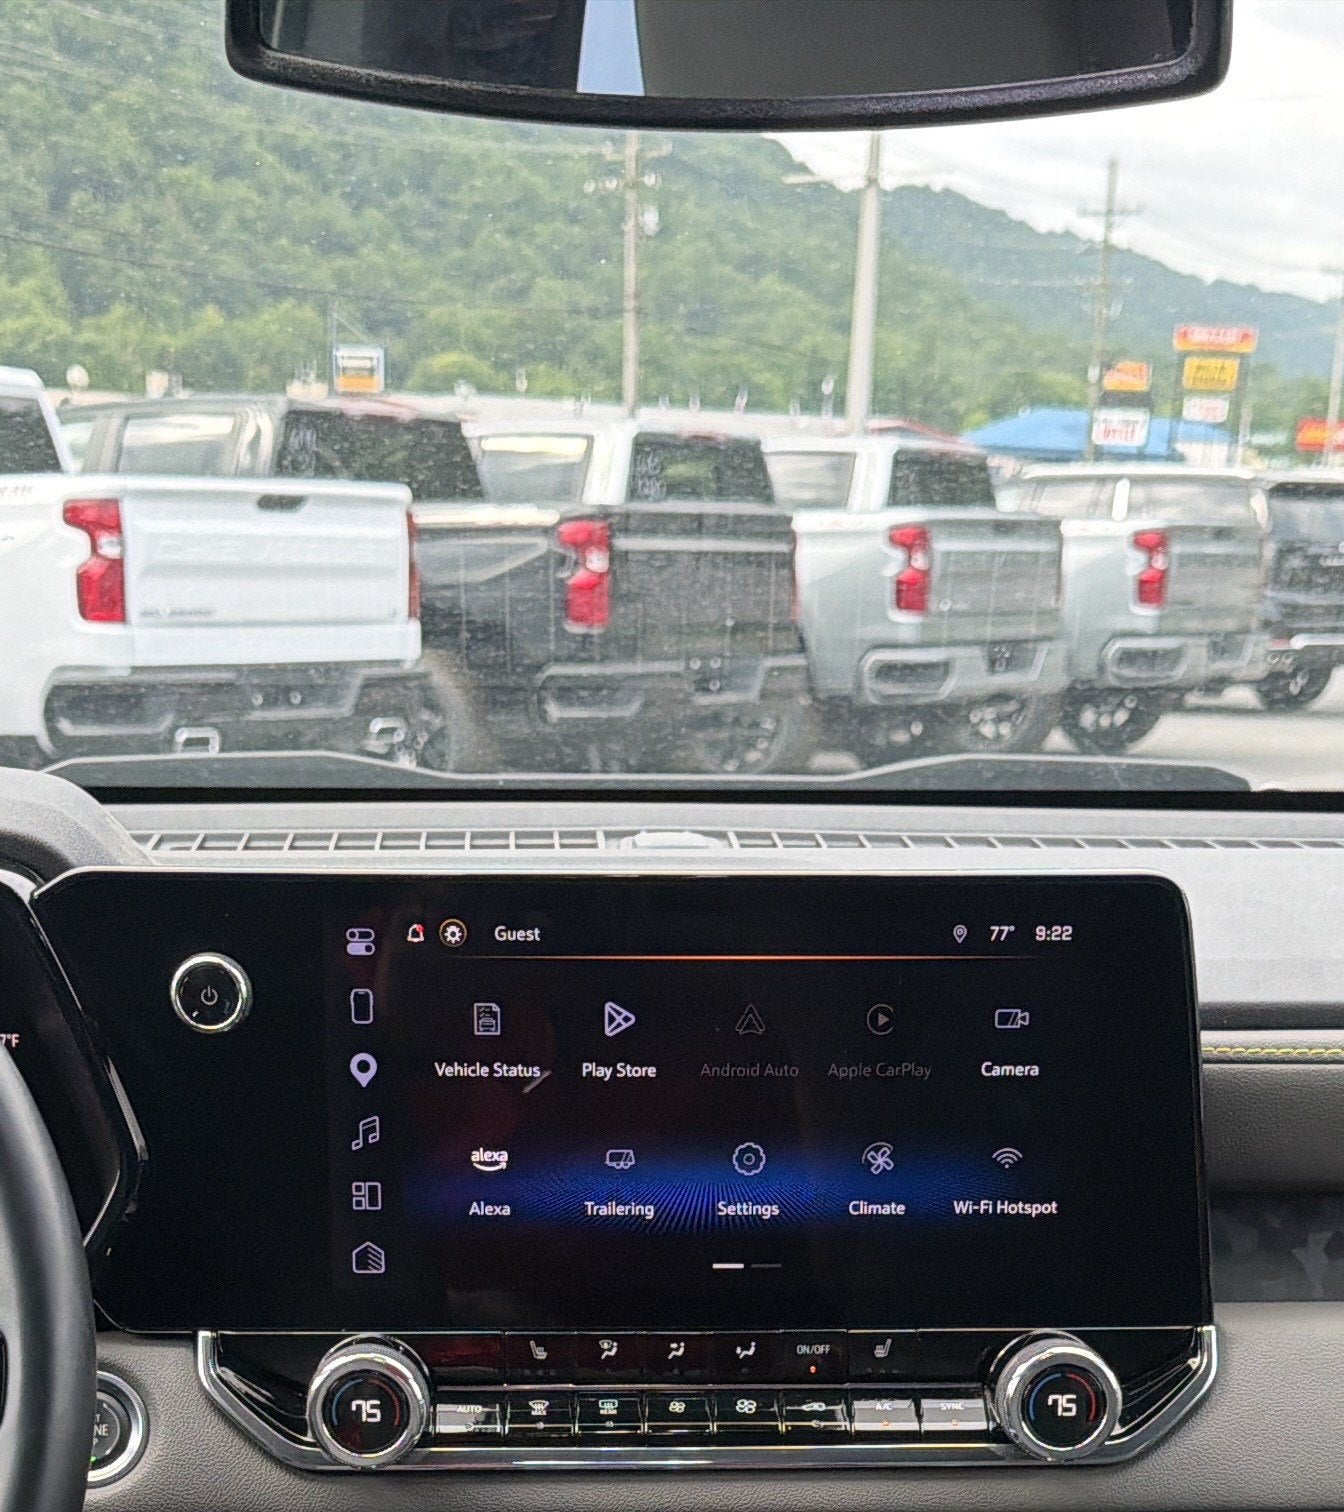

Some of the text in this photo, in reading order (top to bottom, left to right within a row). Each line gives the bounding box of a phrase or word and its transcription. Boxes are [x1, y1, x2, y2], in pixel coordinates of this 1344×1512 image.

[494, 925, 541, 942] Guest
[989, 925, 1015, 941] 77°
[1035, 925, 1073, 941] 9:22
[434, 1061, 541, 1078] Vehicle Status
[582, 1062, 657, 1082] Play Store
[700, 1062, 799, 1078] Android Auto
[827, 1062, 931, 1082] Apple CarPlay
[981, 1062, 1039, 1078] Camera
[470, 1147, 509, 1162] alexa
[469, 1201, 511, 1217] Alexa
[584, 1201, 655, 1221] Trailering
[717, 1200, 780, 1220] Settings
[848, 1200, 906, 1216] Climate
[953, 1200, 1058, 1219] Wi-Fi Hotspot
[796, 1344, 831, 1355] ON/OFF
[351, 1399, 382, 1423] 75
[456, 1405, 483, 1414] AUTO
[875, 1402, 893, 1412] A/C
[940, 1402, 965, 1412] SYNC
[1047, 1394, 1077, 1417] 75
